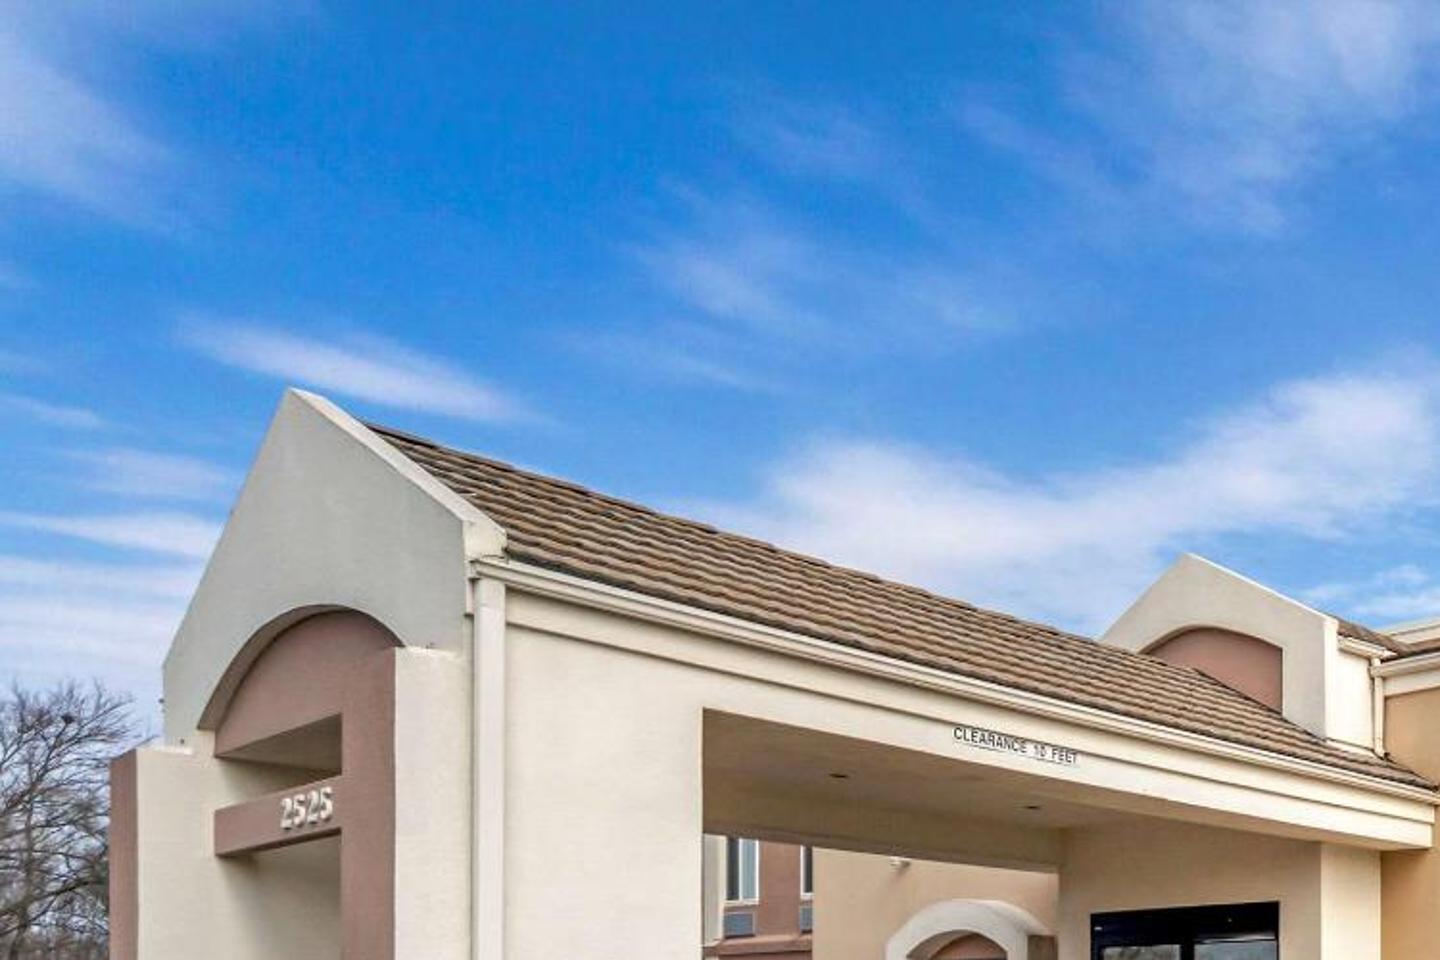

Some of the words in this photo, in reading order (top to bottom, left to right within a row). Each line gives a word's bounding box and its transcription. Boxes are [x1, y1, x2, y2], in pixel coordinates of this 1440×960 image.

[953, 727, 1027, 754] CLEARANCE
[1033, 744, 1046, 758] 10
[1051, 748, 1078, 764] FEET
[280, 786, 334, 830] 2525
